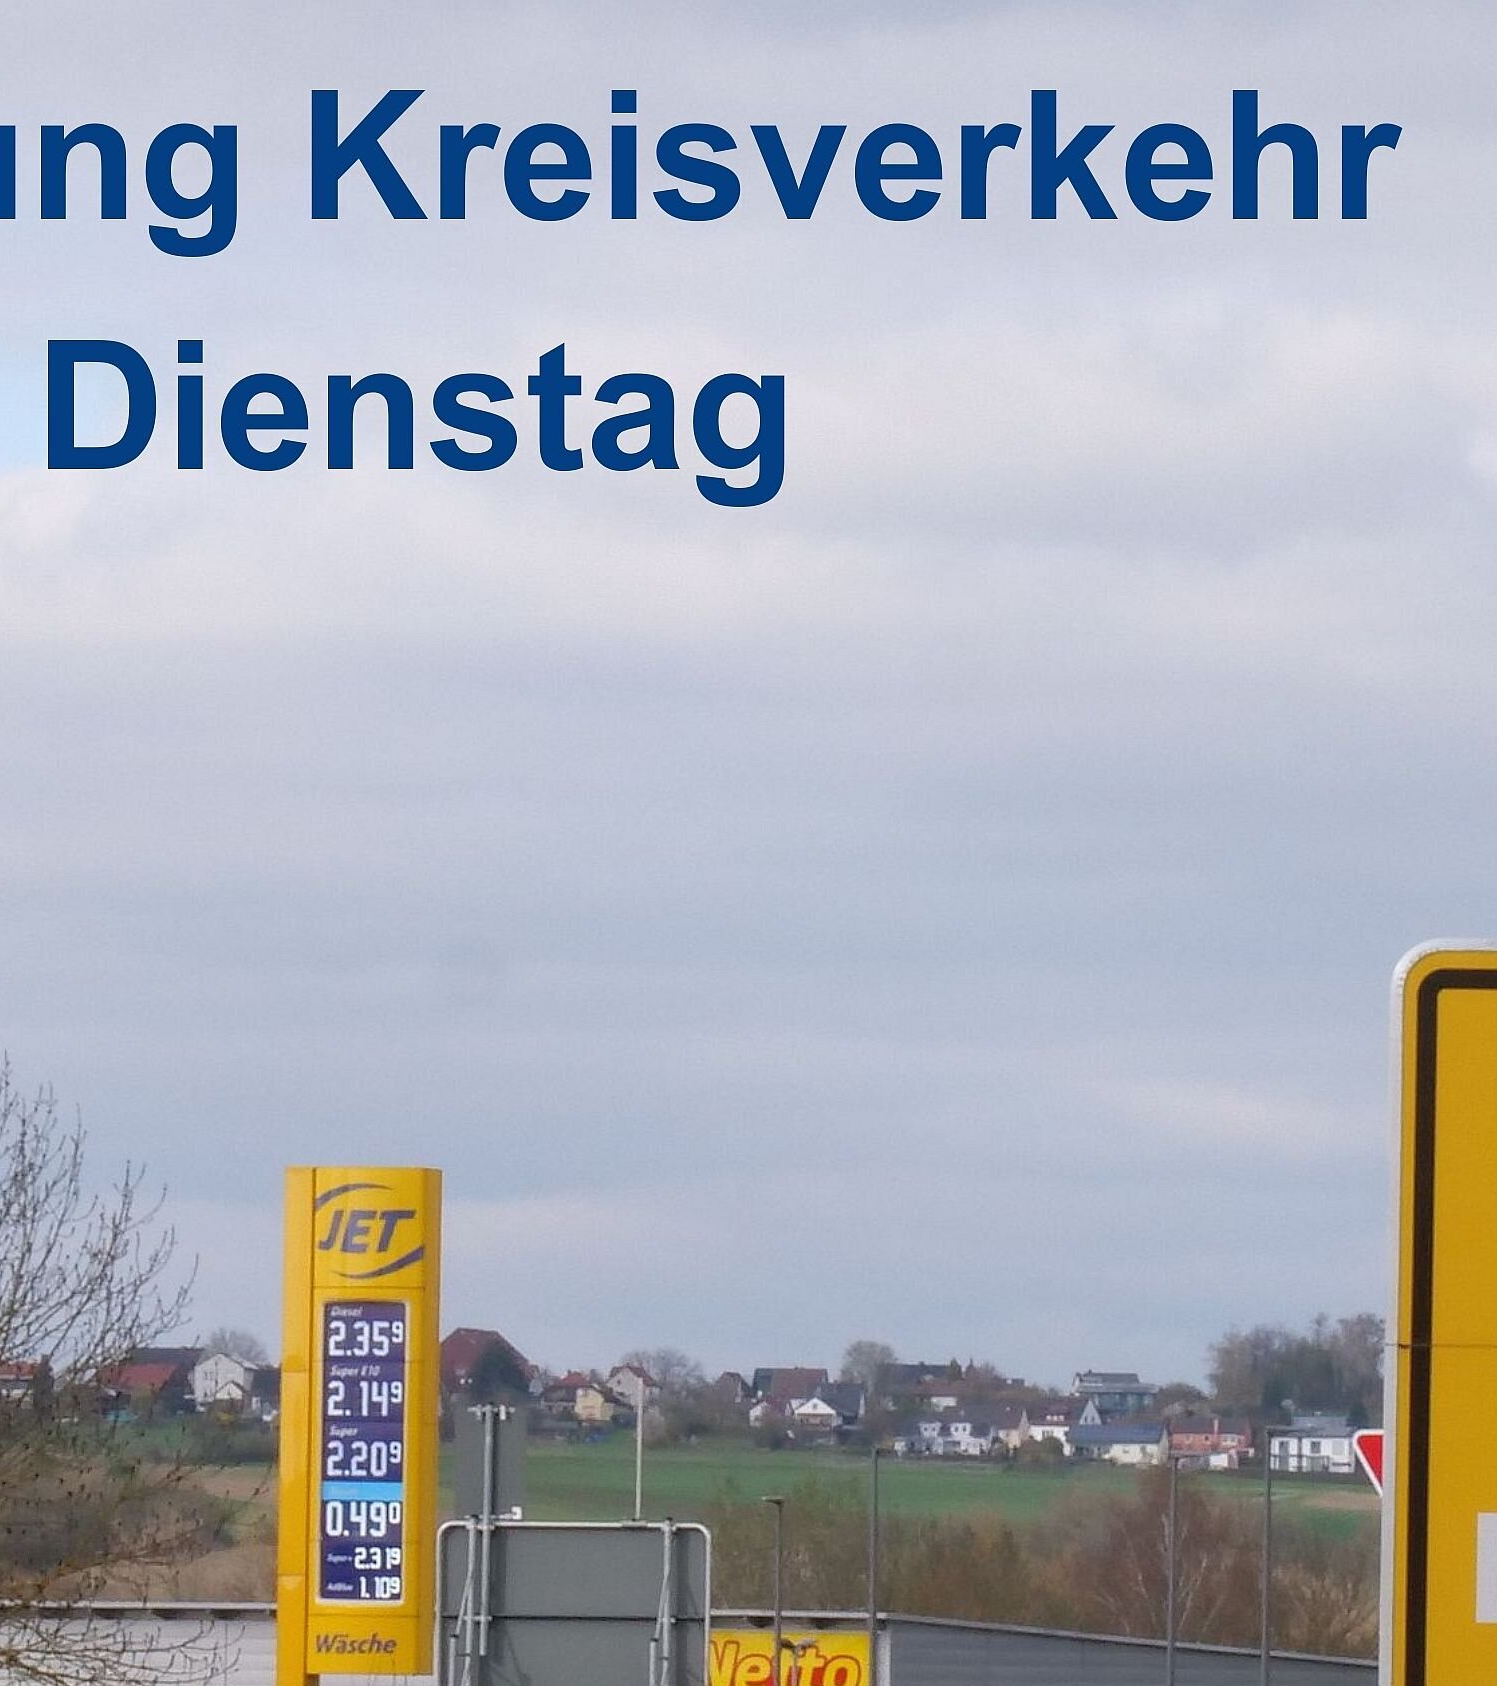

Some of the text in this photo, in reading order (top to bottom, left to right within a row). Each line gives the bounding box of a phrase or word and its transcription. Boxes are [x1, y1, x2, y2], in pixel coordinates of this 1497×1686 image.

[318, 1210, 417, 1253] JET
[330, 1306, 363, 1317] Diesel
[328, 1321, 404, 1357] 2.359
[329, 1365, 358, 1379] Super
[327, 1381, 403, 1417] 2.149
[329, 1425, 358, 1438] Super
[326, 1441, 402, 1477] 2.209
[326, 1501, 401, 1537] 0.490
[354, 1547, 401, 1570] 2.319
[359, 1576, 401, 1598] 1.109
[316, 1632, 397, 1655] Wäsche
